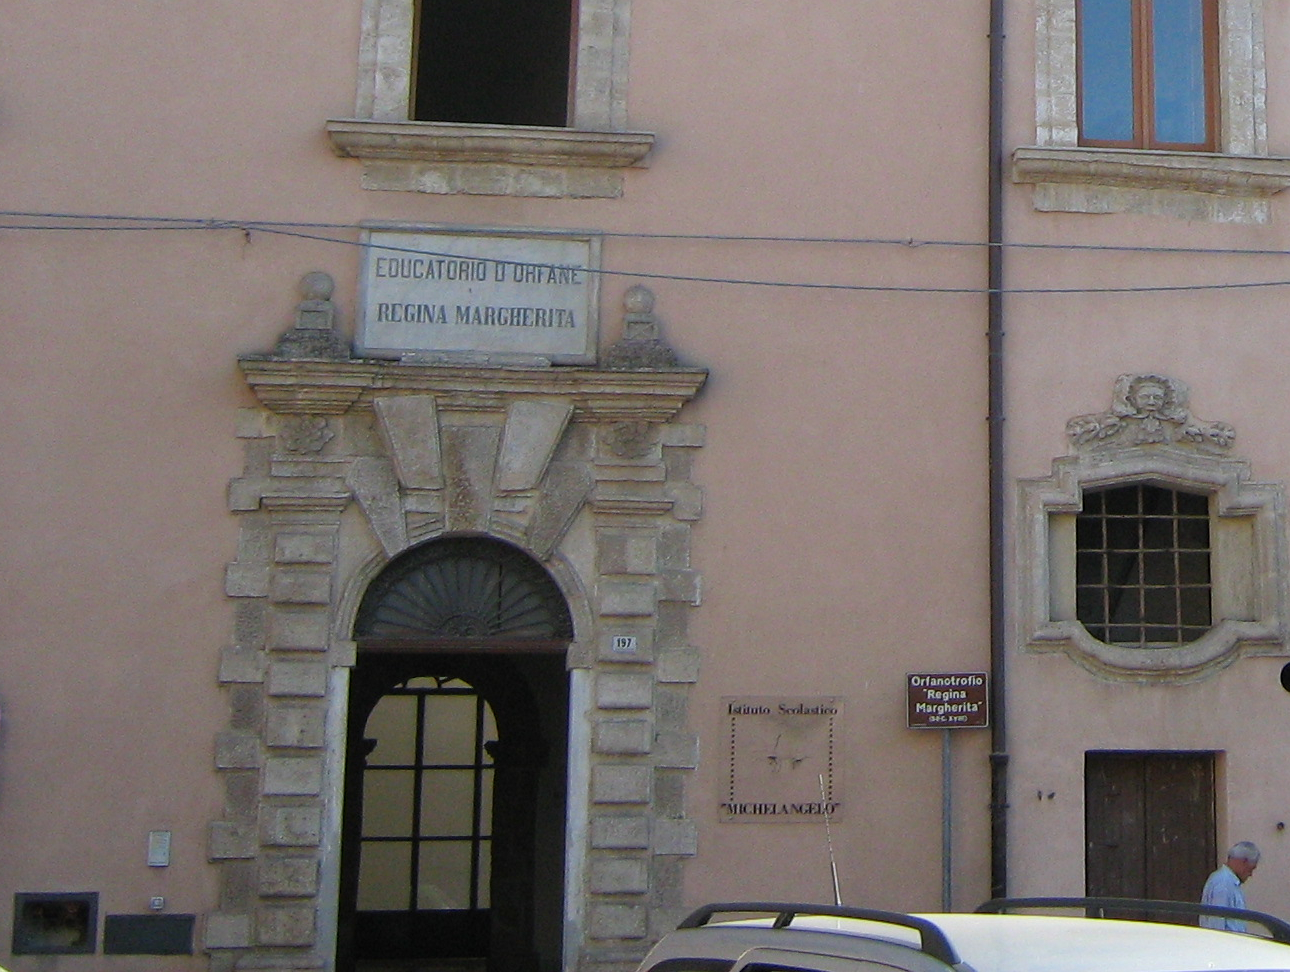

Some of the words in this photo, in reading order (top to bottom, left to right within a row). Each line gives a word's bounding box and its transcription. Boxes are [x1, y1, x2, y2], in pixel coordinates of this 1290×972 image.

[375, 257, 486, 282] EDUCATORIO
[377, 303, 448, 325] REGINA
[455, 305, 575, 329] MARGHERITA
[616, 637, 632, 648] 197
[911, 674, 983, 687] Orfanotrofio
[727, 703, 771, 715] Istituto
[778, 703, 838, 715] Scolastico
